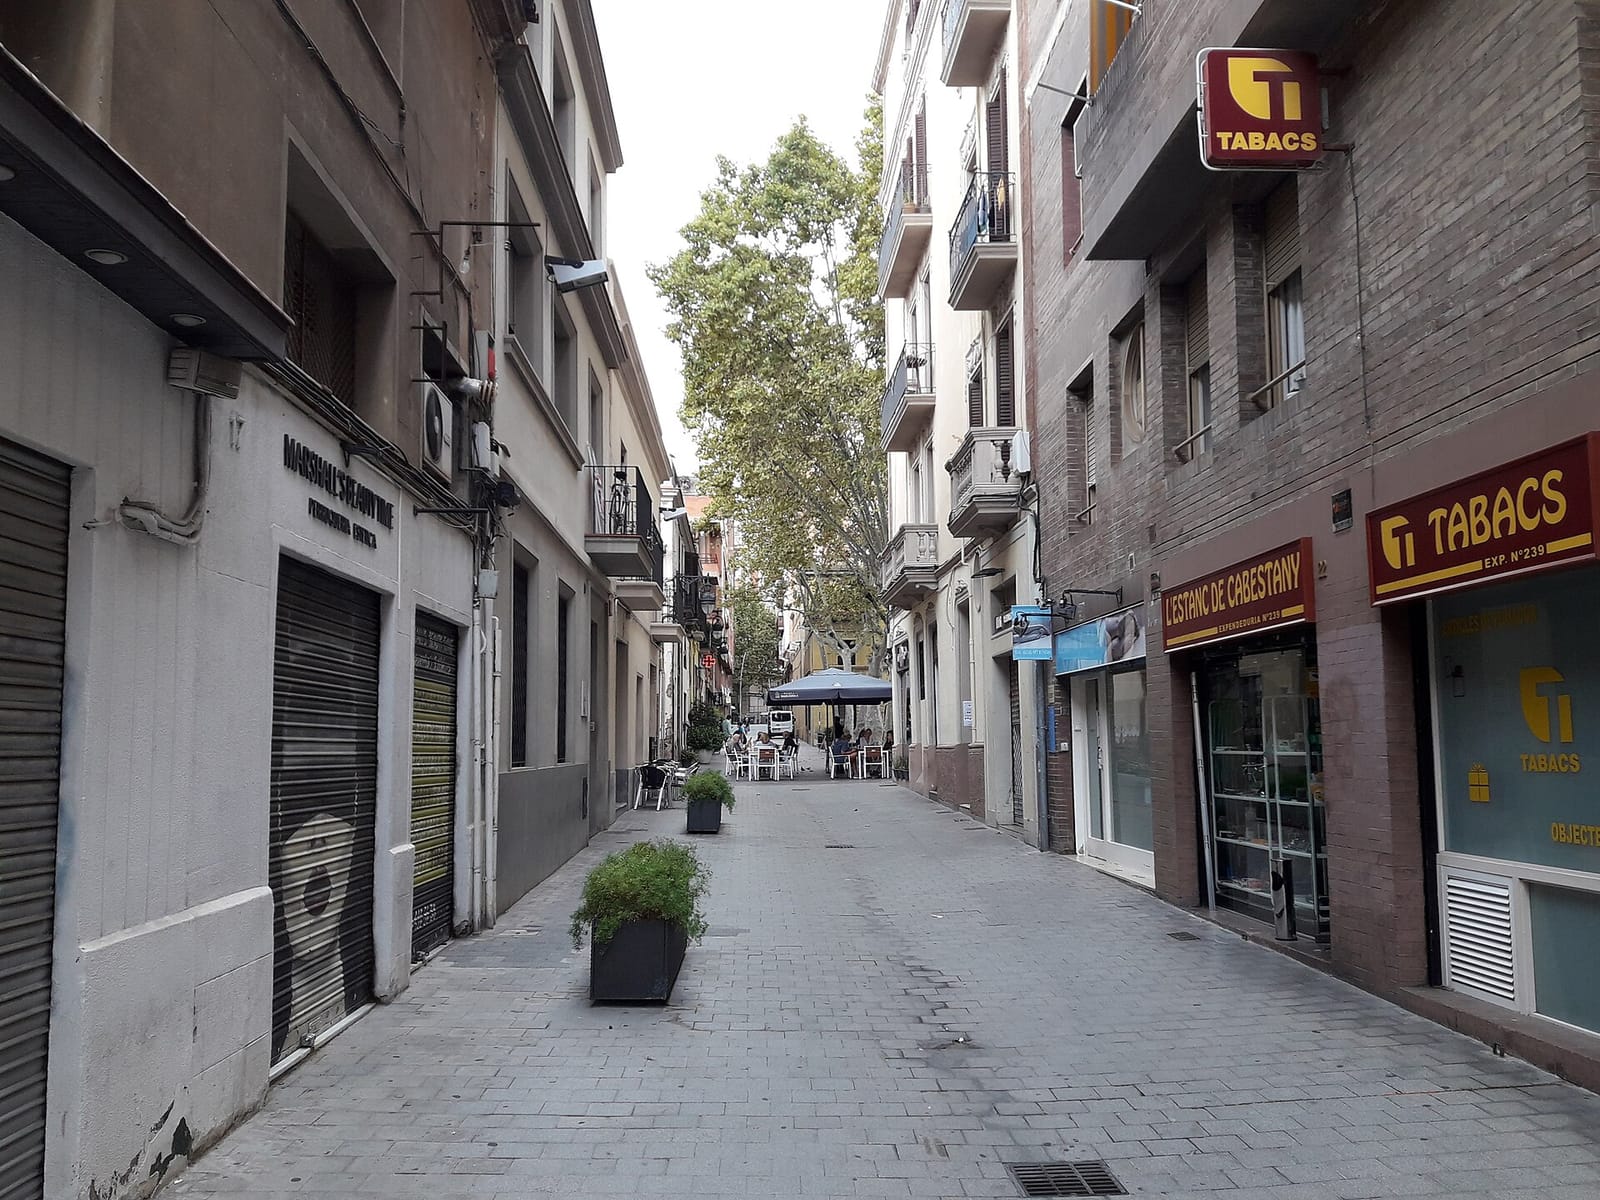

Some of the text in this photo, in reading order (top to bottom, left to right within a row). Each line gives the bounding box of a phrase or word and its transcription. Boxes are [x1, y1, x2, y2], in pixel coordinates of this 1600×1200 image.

[1216, 131, 1317, 151] TABACS
[1427, 469, 1567, 555] TABACS
[1484, 555, 1508, 569] EXP.
[1165, 551, 1300, 626] L'ESTANC DE CABESTANY
[1218, 615, 1262, 633] EXPENDEDURIA
[1520, 753, 1581, 773] TABACS
